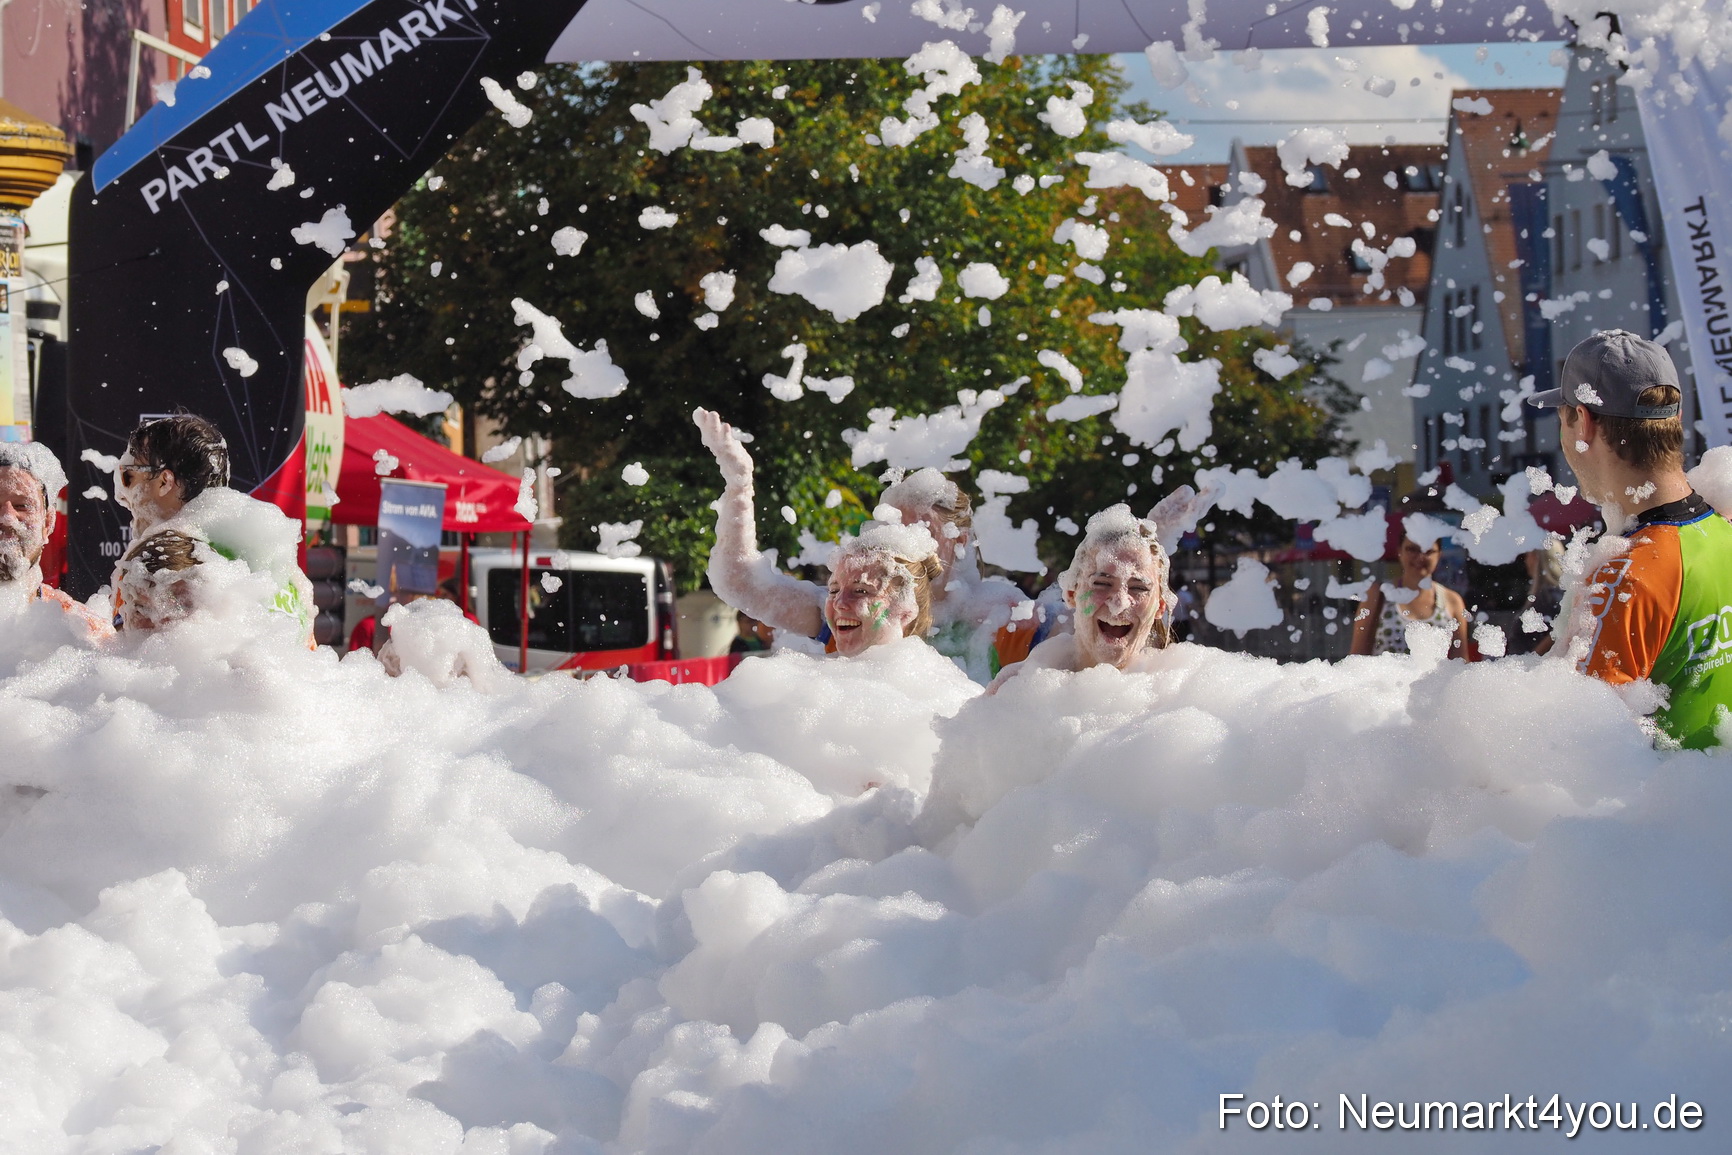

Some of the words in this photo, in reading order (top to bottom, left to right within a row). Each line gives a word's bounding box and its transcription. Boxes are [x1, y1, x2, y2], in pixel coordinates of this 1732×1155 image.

[140, 121, 269, 215] PARTL
[100, 542, 120, 555] 100
[1685, 654, 1724, 675] inspired
